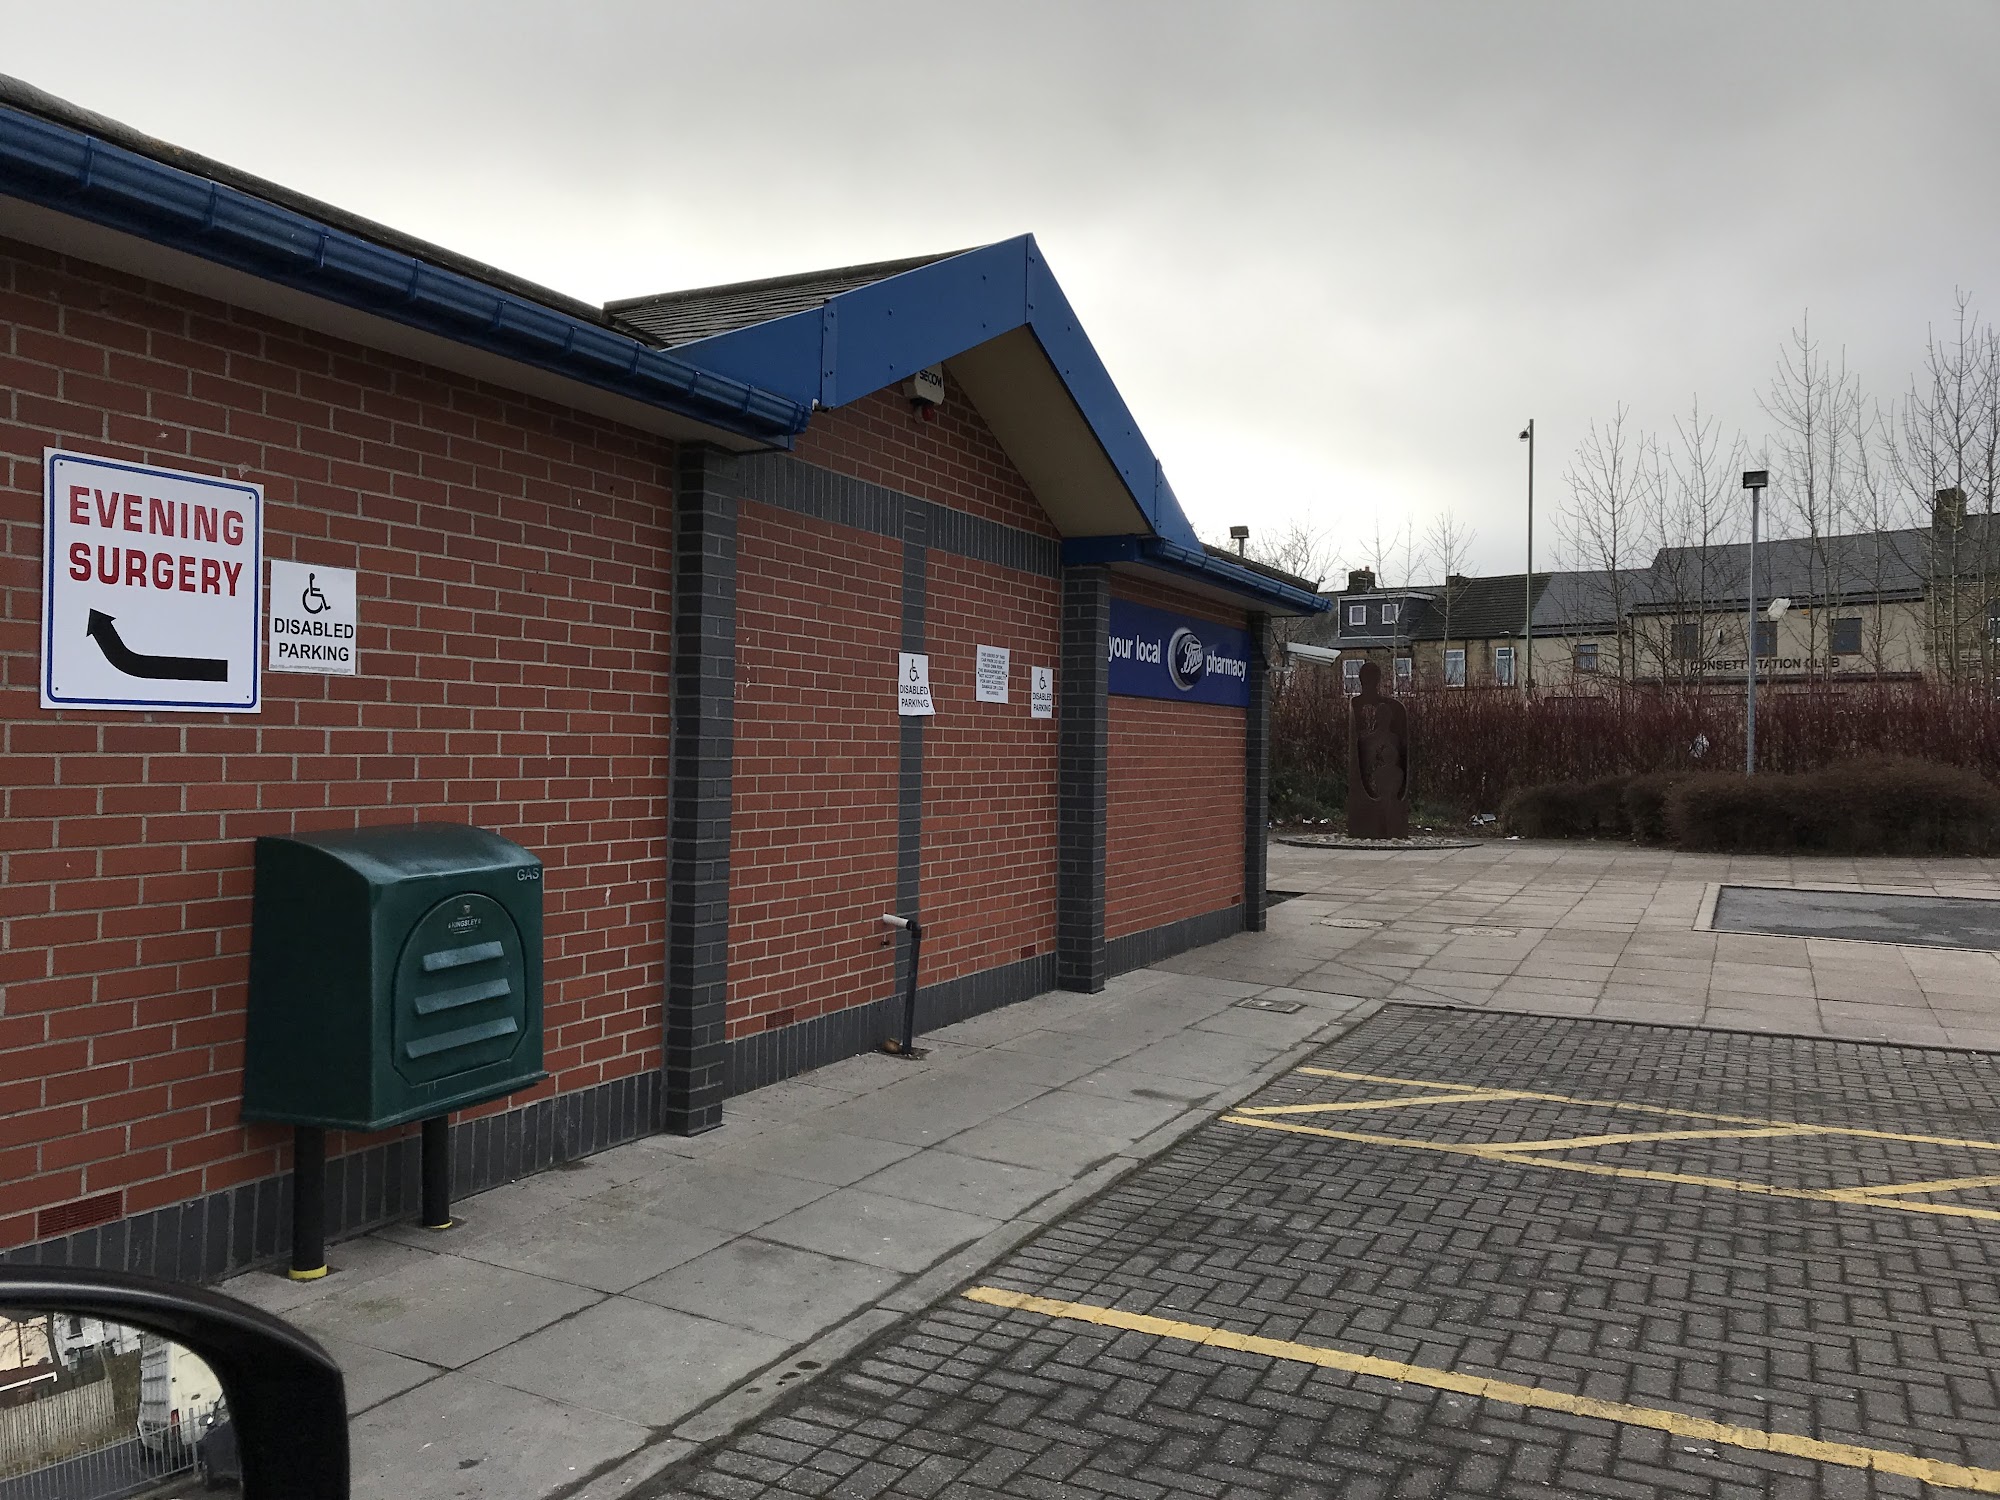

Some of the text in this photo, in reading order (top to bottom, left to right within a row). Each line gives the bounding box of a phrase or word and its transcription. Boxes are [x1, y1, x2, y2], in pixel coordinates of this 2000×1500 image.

[69, 485, 244, 546] EVENING
[69, 542, 243, 597] SURGERY
[274, 618, 354, 639] DISABLED
[278, 642, 350, 662] PARKING
[1108, 635, 1134, 663] your
[1136, 634, 1161, 664] local
[1206, 650, 1247, 682] pharmacy
[899, 684, 929, 695] DISABLED
[901, 698, 930, 708] PARKING
[1032, 692, 1052, 701] DISABLED
[1033, 703, 1051, 712] PARKING
[516, 868, 540, 881] GAS
[451, 918, 478, 929] KINGSLEY
